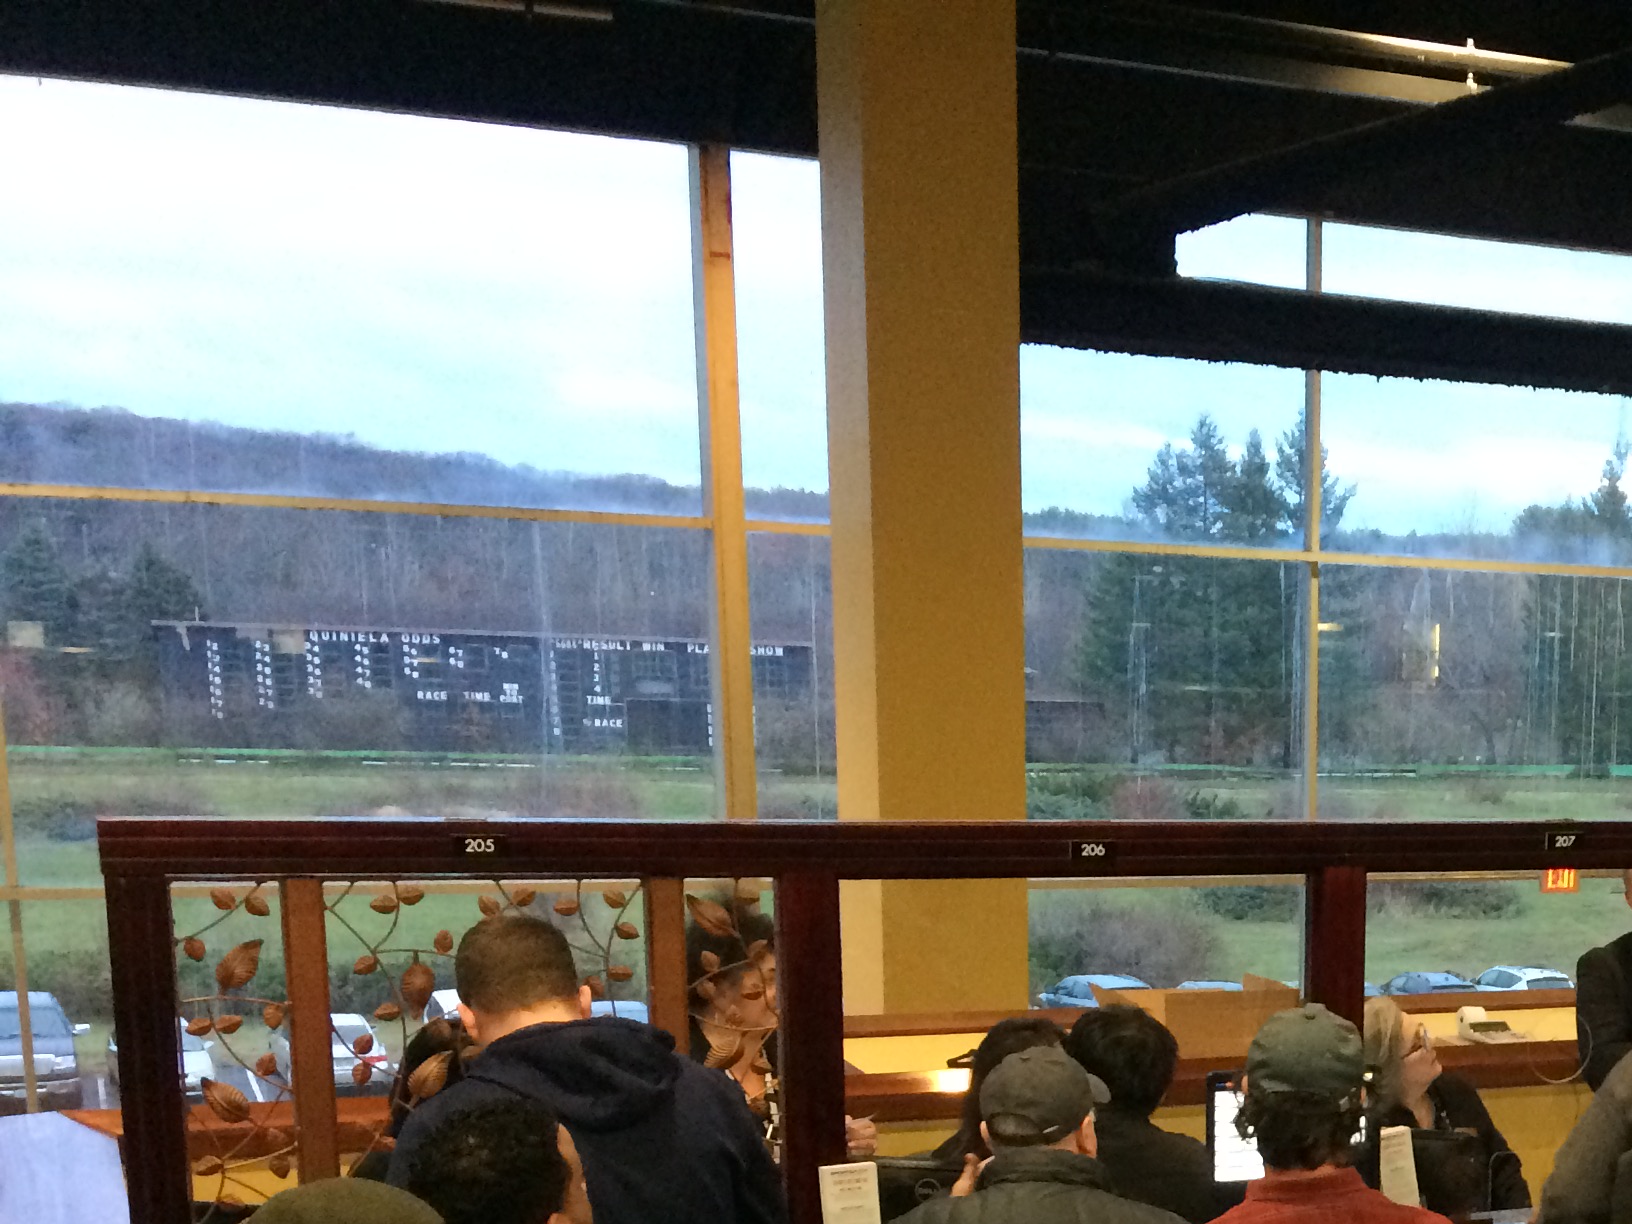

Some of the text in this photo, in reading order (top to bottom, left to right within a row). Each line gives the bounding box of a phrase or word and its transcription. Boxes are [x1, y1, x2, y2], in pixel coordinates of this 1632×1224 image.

[401, 633, 440, 644] ODDS
[687, 643, 709, 654] PLA
[417, 691, 448, 701] RACE
[594, 719, 623, 728] RACE
[464, 838, 495, 853] 205
[1554, 835, 1576, 848] 207
[1081, 843, 1106, 857] 206
